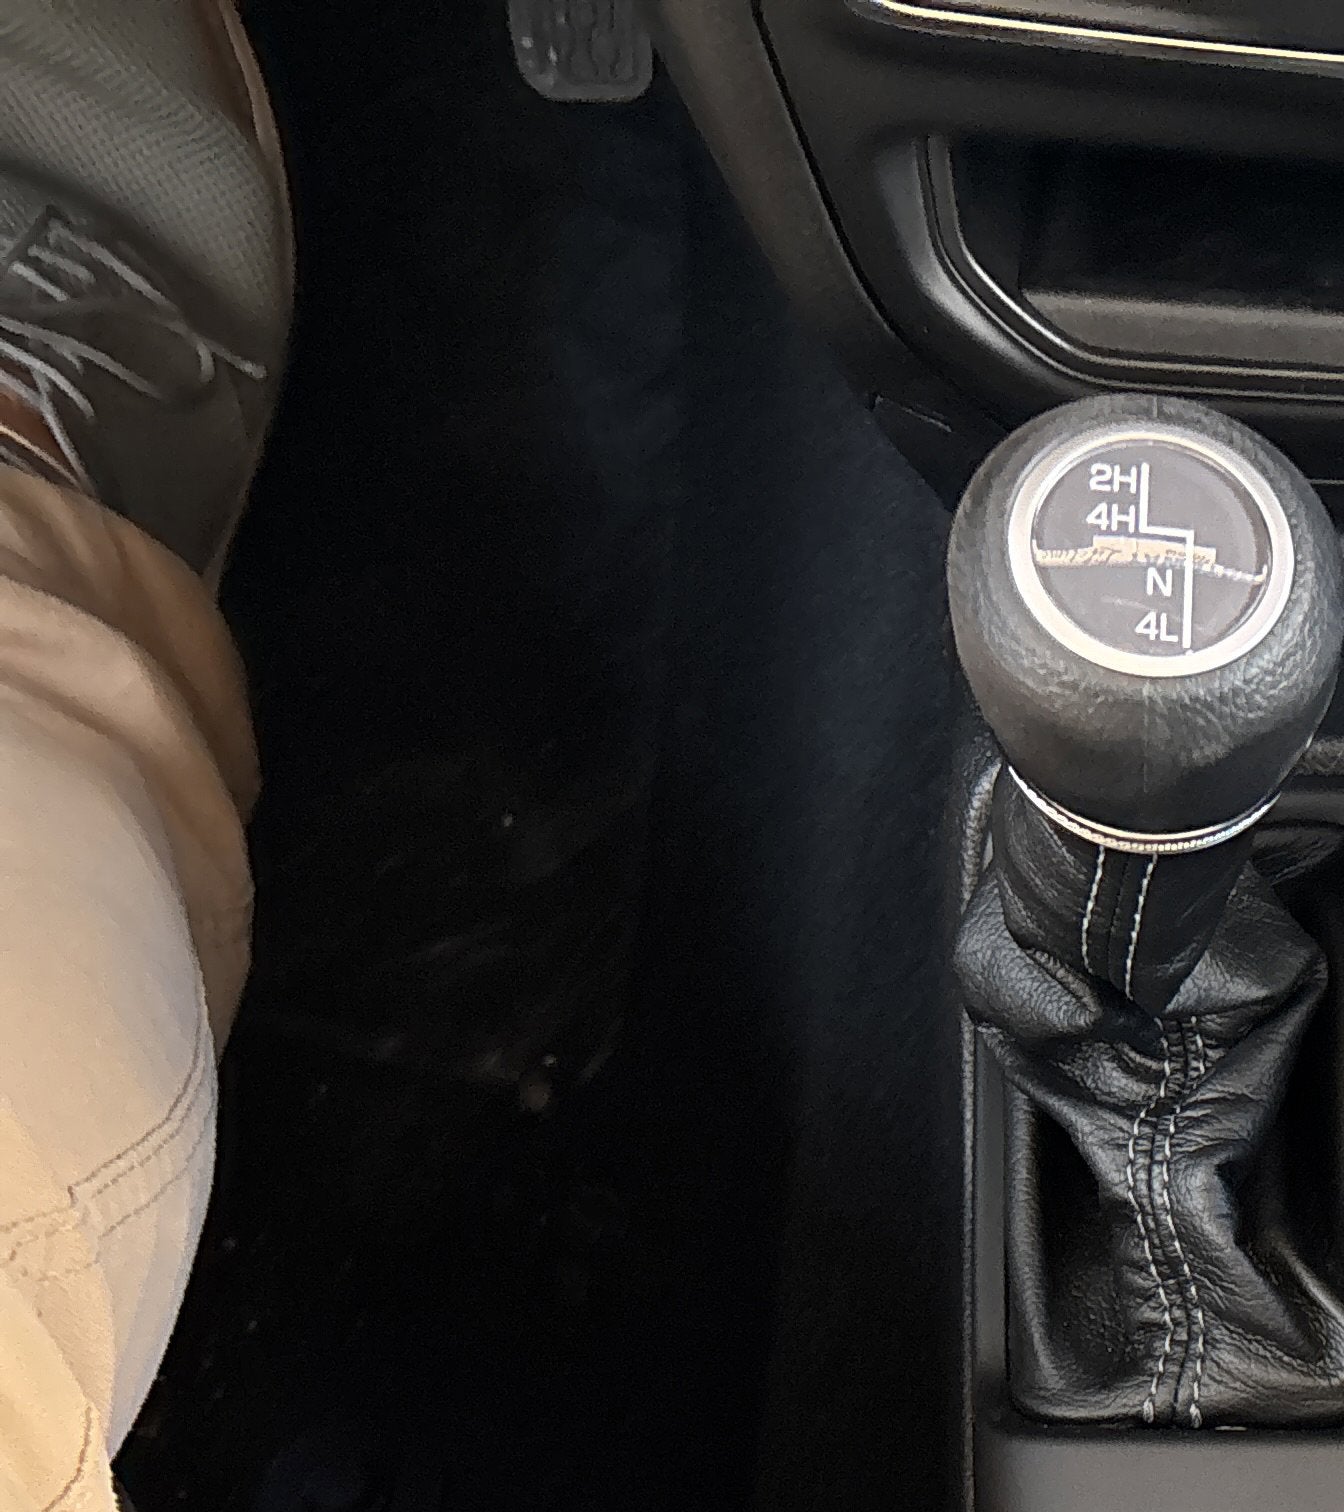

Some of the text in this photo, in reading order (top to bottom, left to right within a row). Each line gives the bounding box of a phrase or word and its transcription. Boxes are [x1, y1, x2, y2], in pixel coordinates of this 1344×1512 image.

[1089, 462, 1138, 494] 2H
[1086, 502, 1137, 533] 4H
[1146, 566, 1174, 597] N
[1134, 611, 1180, 643] 4L
